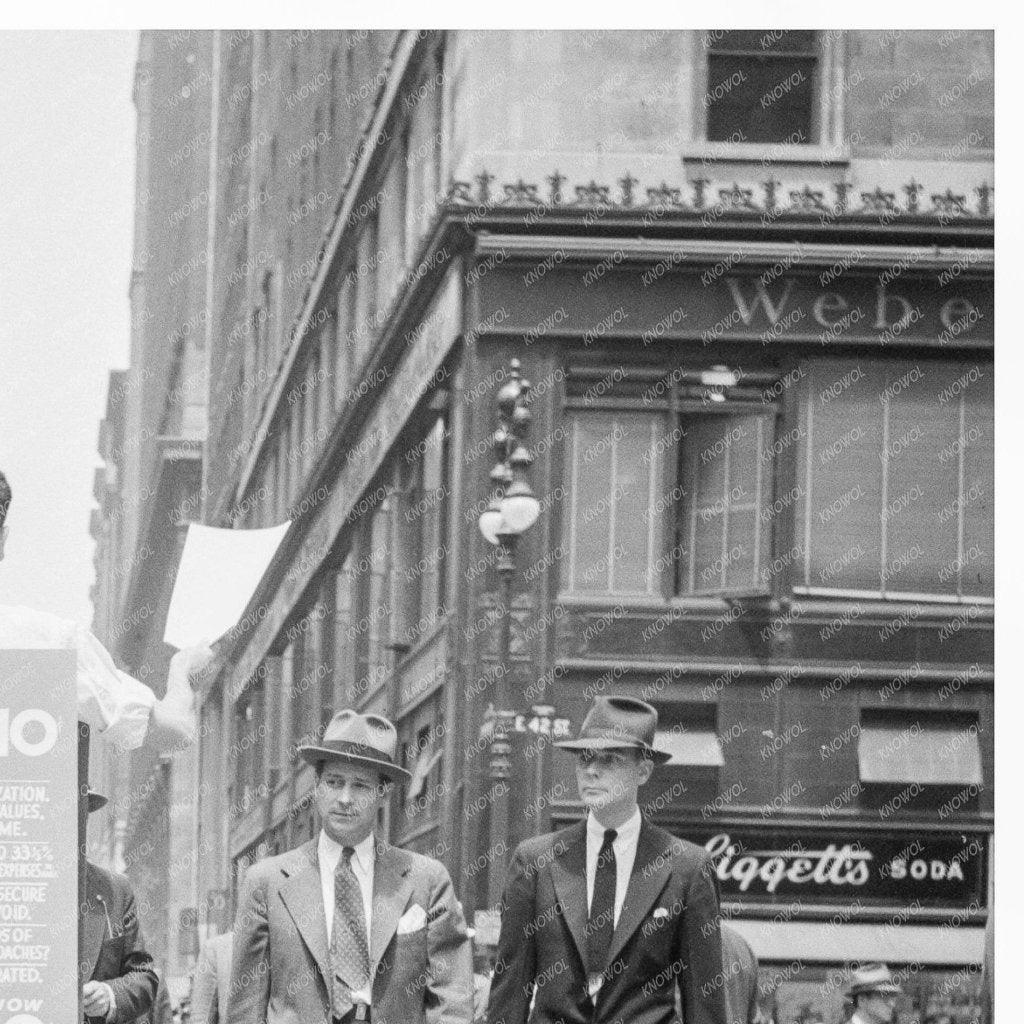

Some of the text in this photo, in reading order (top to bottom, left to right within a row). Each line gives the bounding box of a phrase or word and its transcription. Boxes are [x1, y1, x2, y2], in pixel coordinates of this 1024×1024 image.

[727, 278, 976, 330] Webe
[890, 859, 964, 881] SODA
[13, 928, 32, 943] OF
